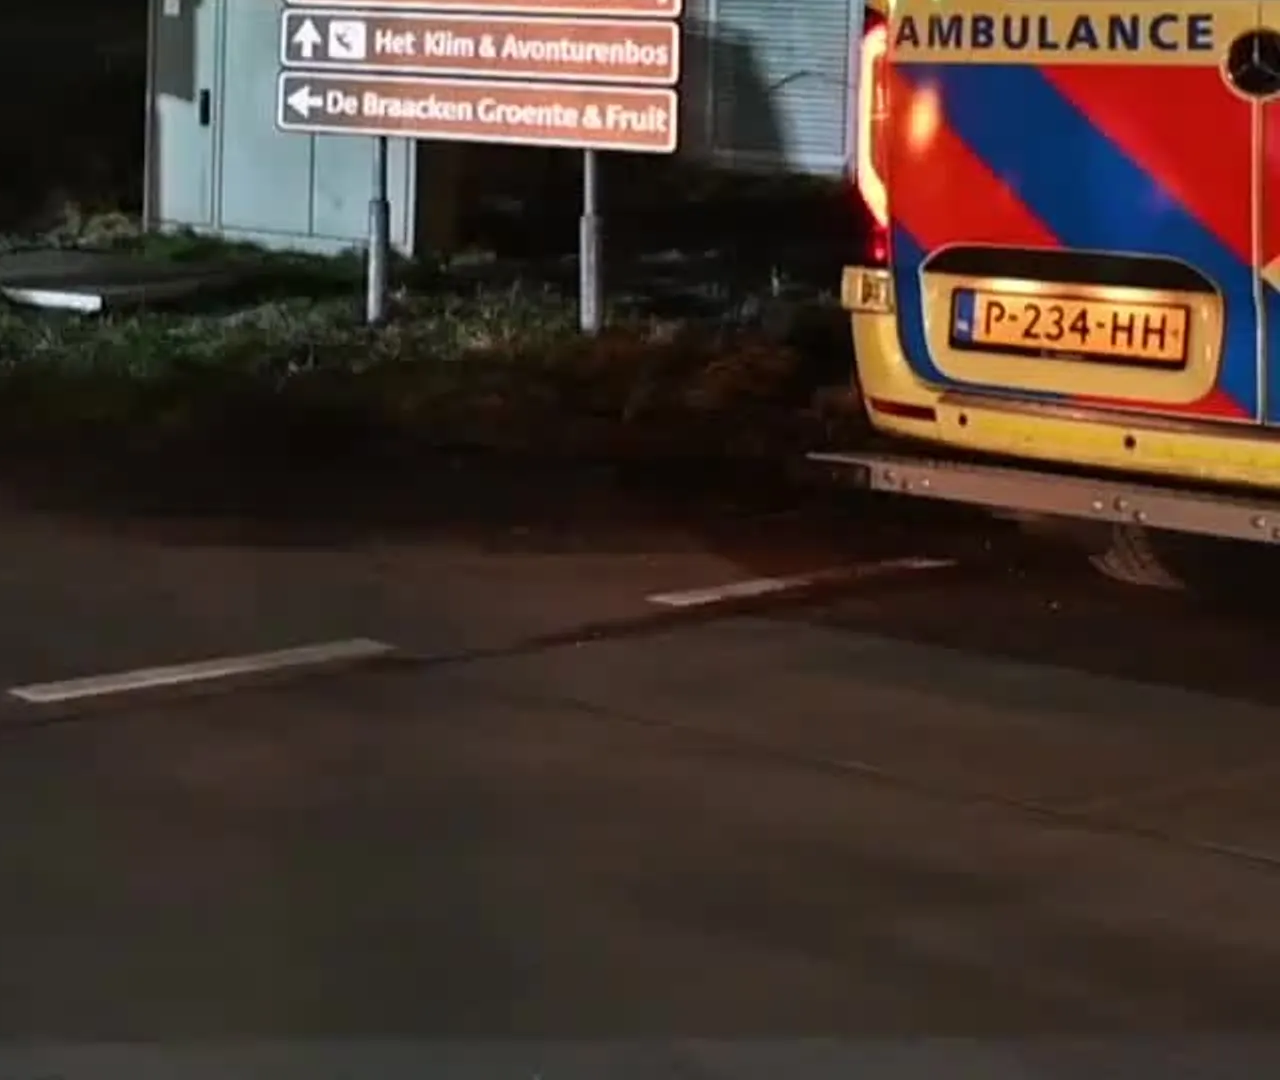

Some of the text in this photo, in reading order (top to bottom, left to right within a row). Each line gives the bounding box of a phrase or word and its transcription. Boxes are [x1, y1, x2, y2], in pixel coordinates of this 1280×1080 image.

[375, 29, 669, 66] Het Klim & Avonturenbos
[895, 13, 1214, 51] AMBULANCE
[326, 90, 668, 133] De Braacken Groente & Fruit
[984, 300, 1166, 351] P-234-HH
